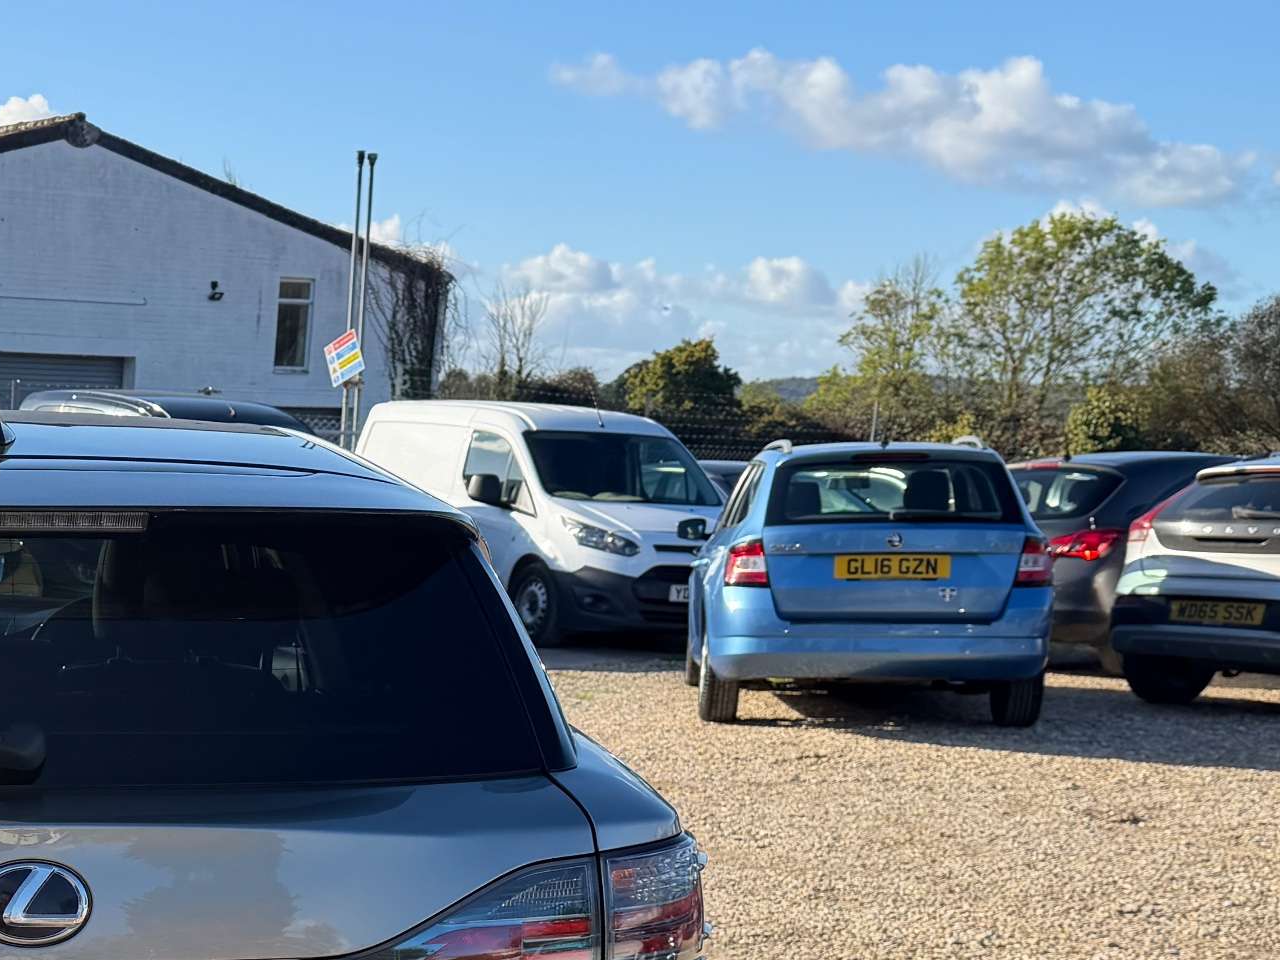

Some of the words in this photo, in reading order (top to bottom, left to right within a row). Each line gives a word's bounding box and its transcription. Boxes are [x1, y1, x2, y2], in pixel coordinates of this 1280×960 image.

[846, 558, 892, 576] GL16
[898, 558, 939, 576] GZN
[1222, 604, 1258, 622] SSK
